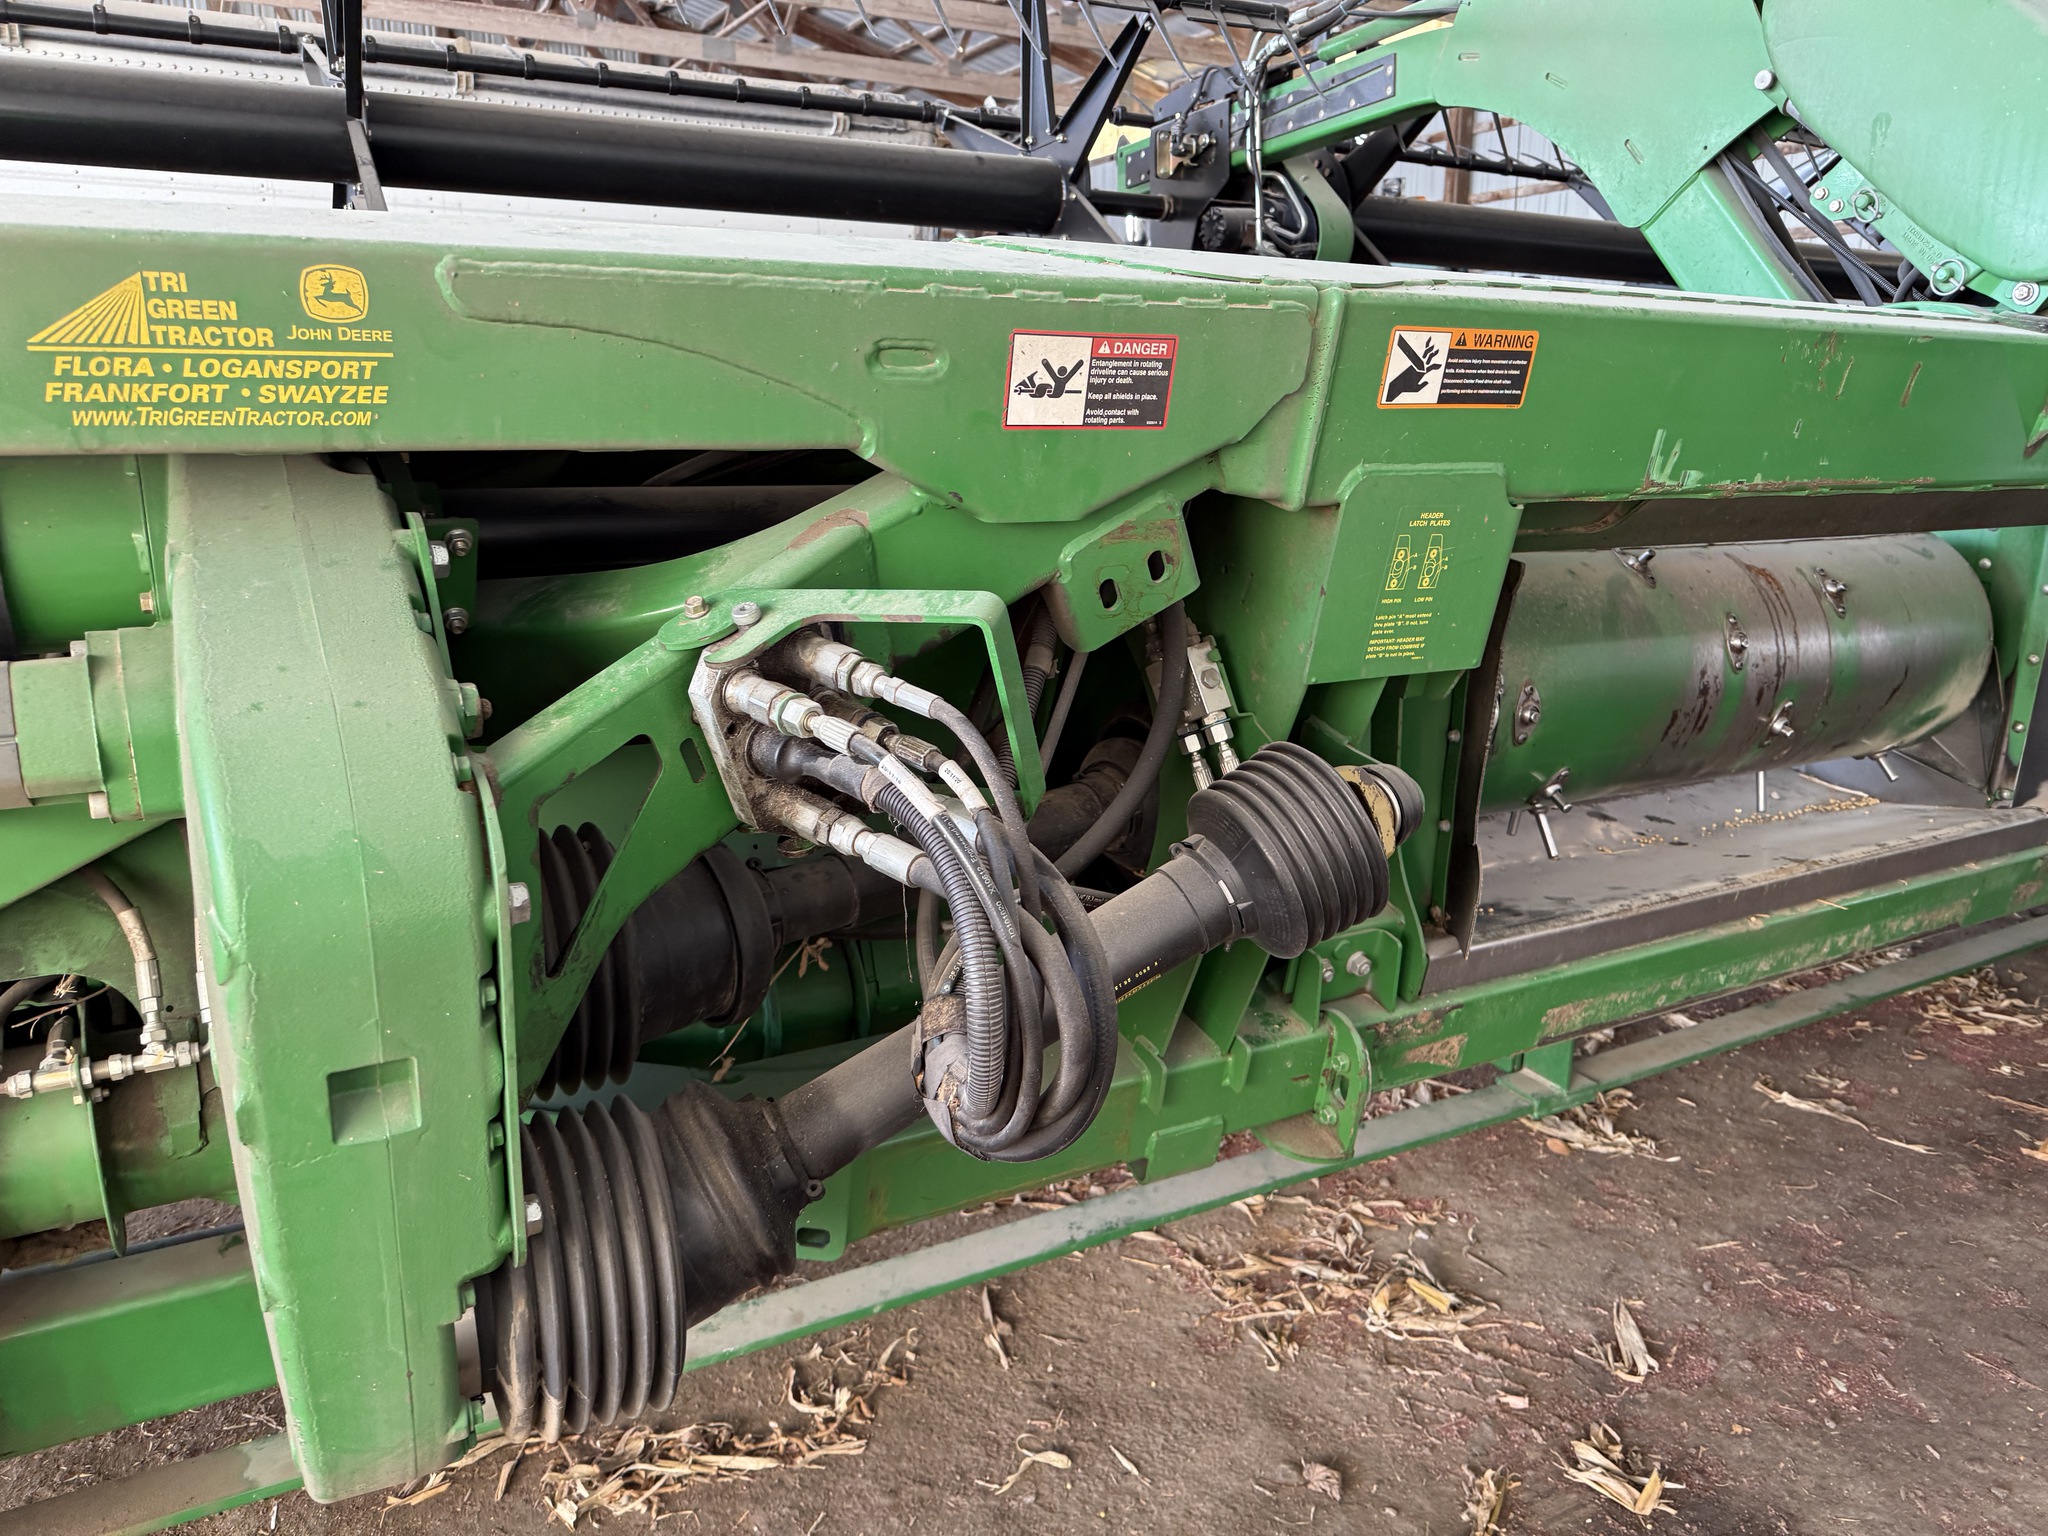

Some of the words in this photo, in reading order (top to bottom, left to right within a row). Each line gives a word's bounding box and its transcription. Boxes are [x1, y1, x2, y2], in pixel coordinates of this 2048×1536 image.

[143, 271, 188, 293] TRI
[148, 299, 237, 321] GREEN
[150, 325, 274, 347] TRACTOR
[287, 325, 332, 341] JOHN
[338, 326, 393, 343] DEERE
[1474, 334, 1534, 348] WARNING
[1114, 342, 1168, 355] DANGER
[54, 356, 154, 377] FLORA
[182, 358, 377, 380] LOGANSPORT
[1092, 359, 1132, 368] Entanglement
[1140, 360, 1163, 369] rotating
[1090, 376, 1108, 385] injury
[1116, 376, 1134, 384] death.
[45, 383, 229, 403] FRANKFORT
[258, 385, 389, 404] SWAYZEE
[1088, 392, 1103, 401] Keep
[1112, 392, 1133, 400] shields
[1141, 393, 1158, 401] place.
[1084, 417, 1108, 425] rotating
